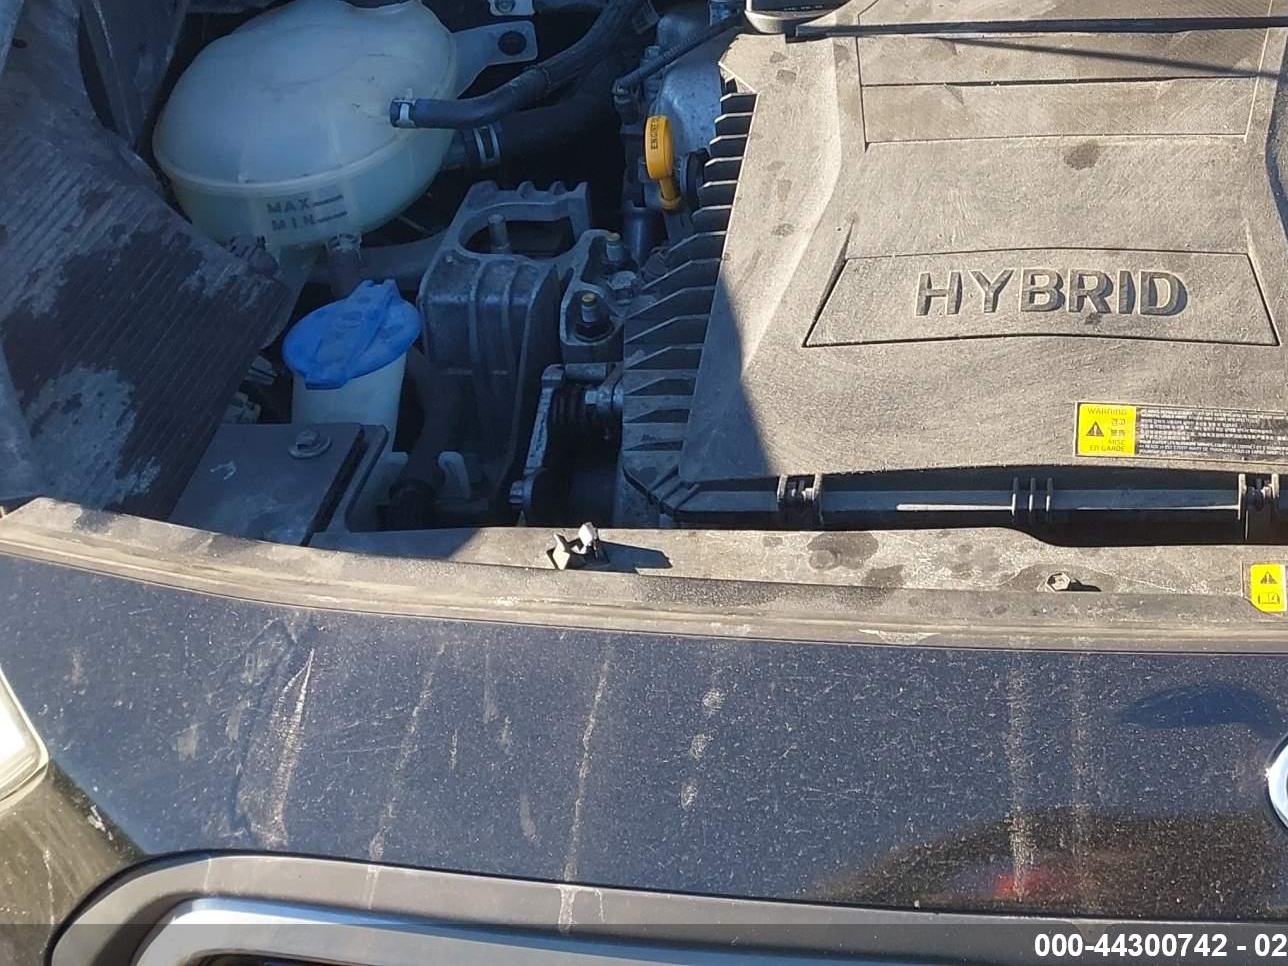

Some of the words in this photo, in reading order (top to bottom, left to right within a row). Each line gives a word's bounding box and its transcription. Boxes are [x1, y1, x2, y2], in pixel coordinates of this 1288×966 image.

[266, 197, 310, 214] MAX
[271, 214, 316, 231] MIN
[915, 267, 1189, 317] HYBRID
